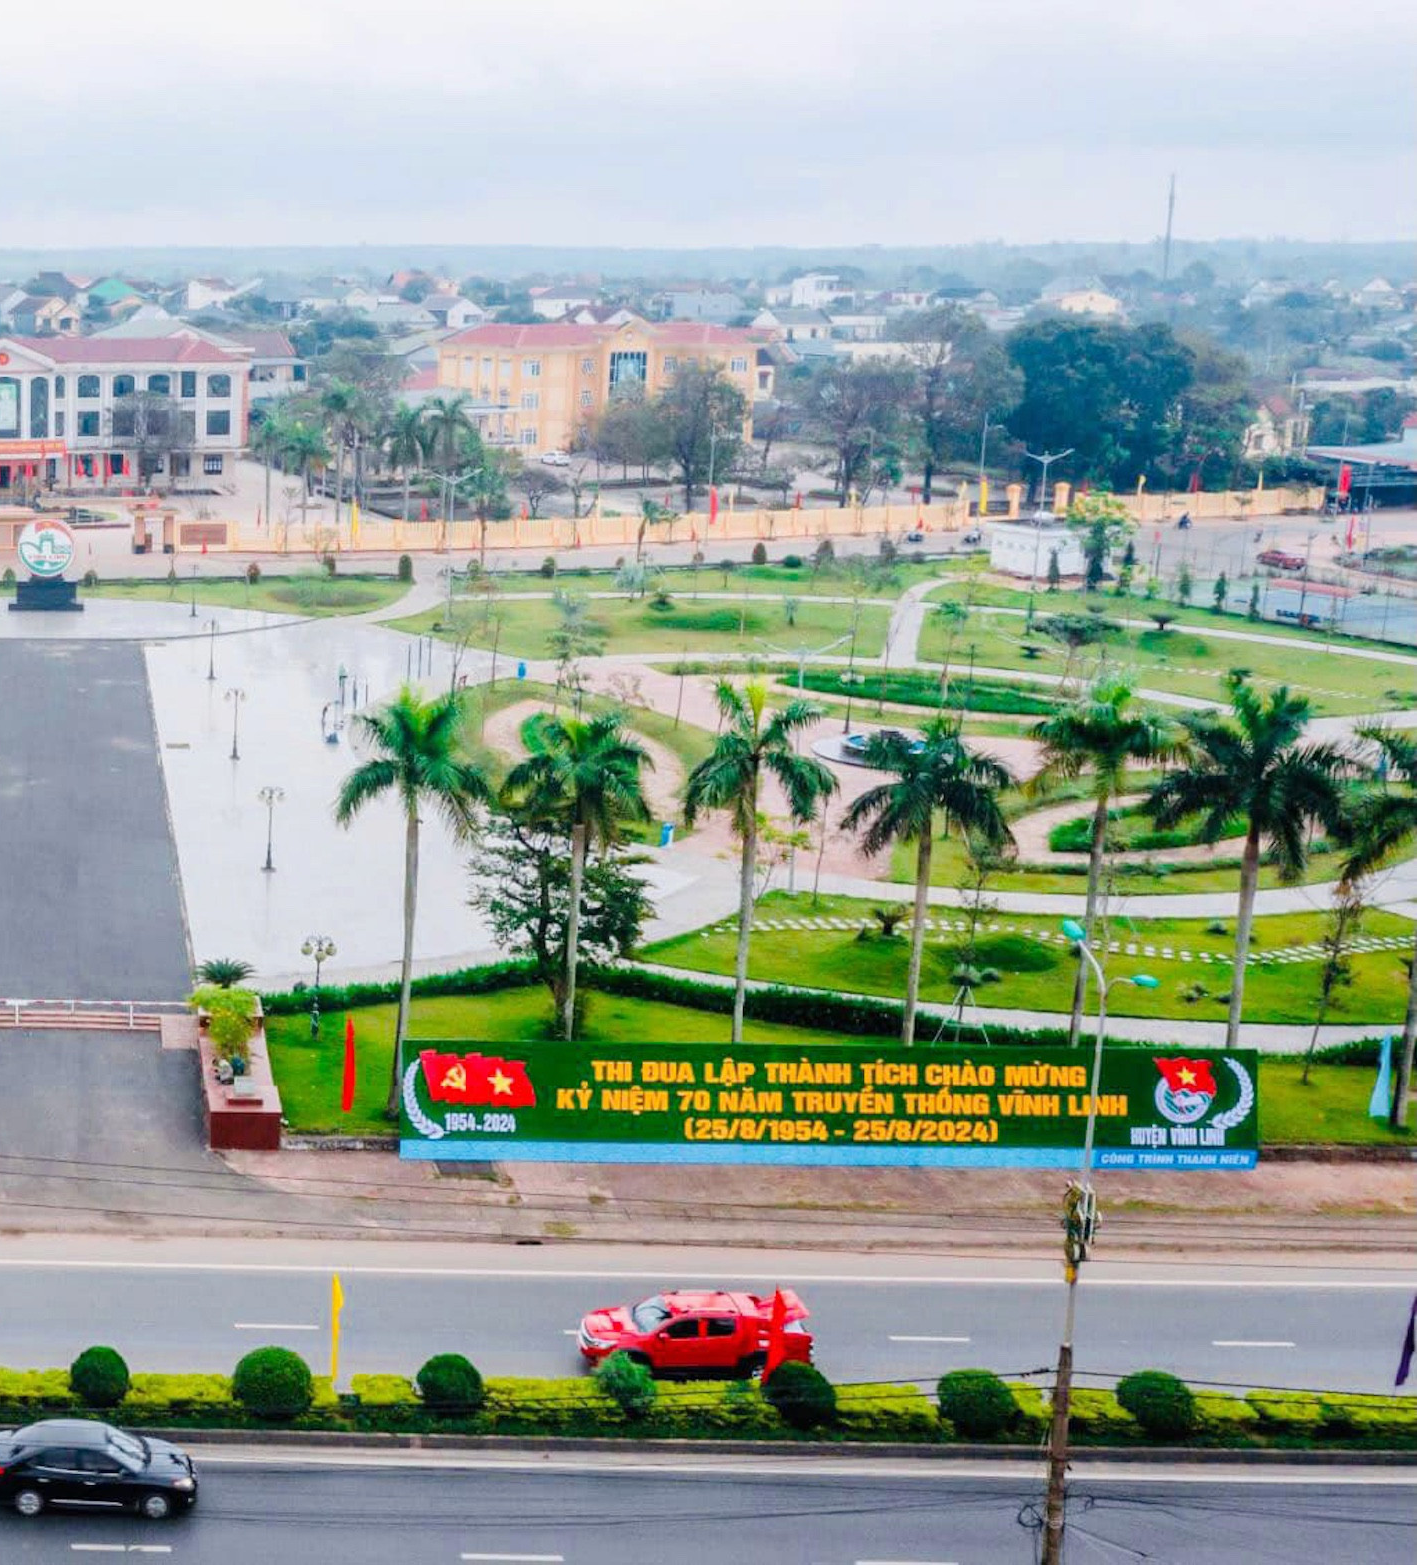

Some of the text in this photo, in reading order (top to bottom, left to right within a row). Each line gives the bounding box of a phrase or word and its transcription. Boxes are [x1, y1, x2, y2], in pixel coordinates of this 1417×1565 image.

[591, 1057, 1087, 1087] THI ĐUA LẬP THÀNH TÍCH CHÀO MỪNG
[556, 1081, 593, 1110] KỶ
[601, 1085, 669, 1115] NIỆM
[677, 1090, 711, 1111] 70
[718, 1087, 783, 1113] NĂM
[903, 1086, 990, 1115] THỐNG
[997, 1089, 1060, 1116] VĨNH
[1068, 1094, 1128, 1116] LINH
[684, 1117, 829, 1141] (25/8/1954
[852, 1119, 999, 1142] 25/8/2024)
[1130, 1124, 1167, 1149] HUYỆN
[1199, 1128, 1225, 1146] LINH
[1101, 1152, 1134, 1164] CÔNG
[1177, 1154, 1216, 1164] THANH
